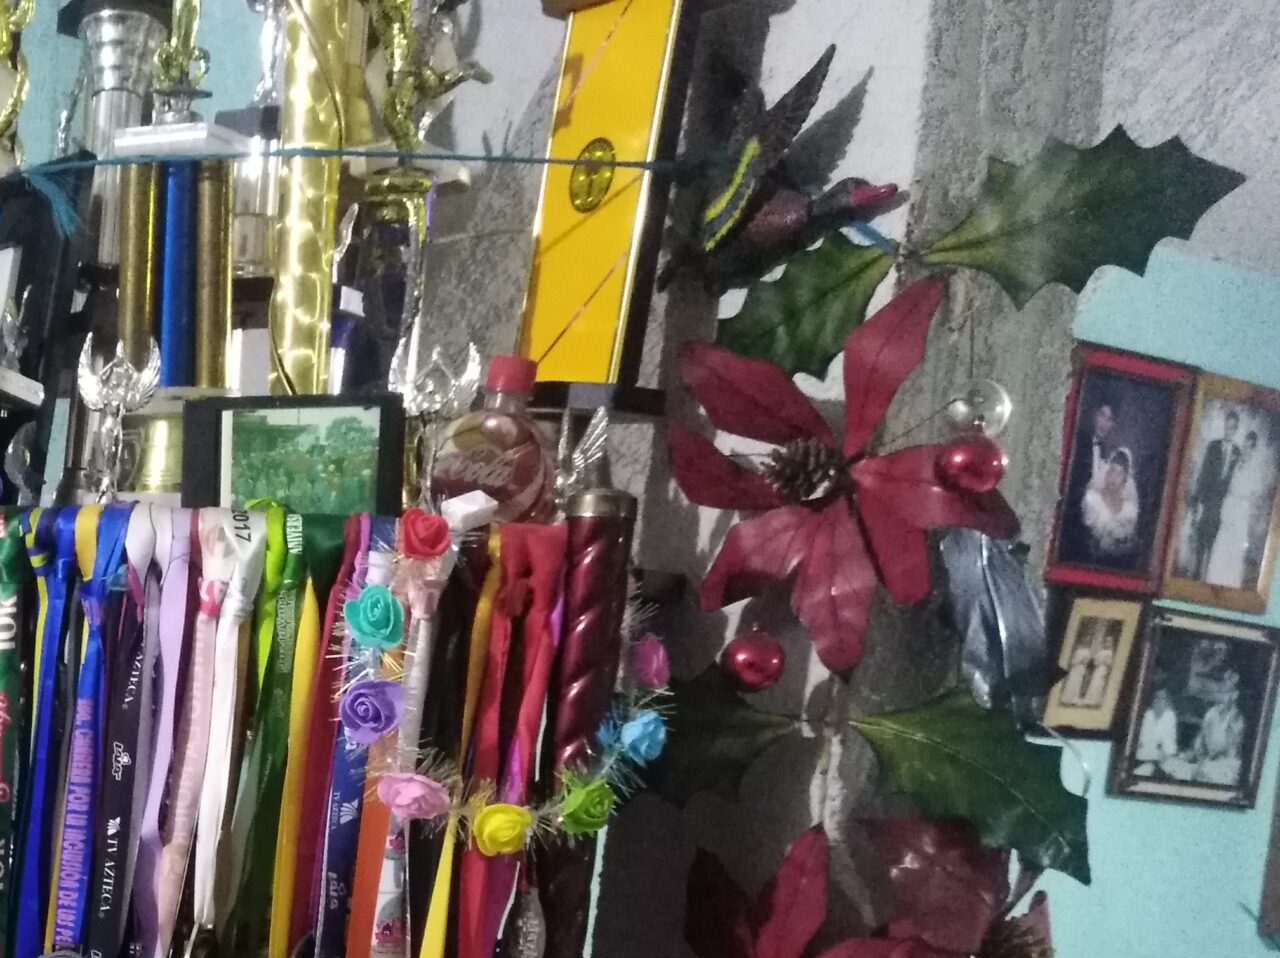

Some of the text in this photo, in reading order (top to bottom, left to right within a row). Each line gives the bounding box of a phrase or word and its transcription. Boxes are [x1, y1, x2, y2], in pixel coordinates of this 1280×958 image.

[286, 513, 304, 555] ANIVERS
[99, 837, 120, 913] TV AZTECA
[58, 890, 79, 907] DE
